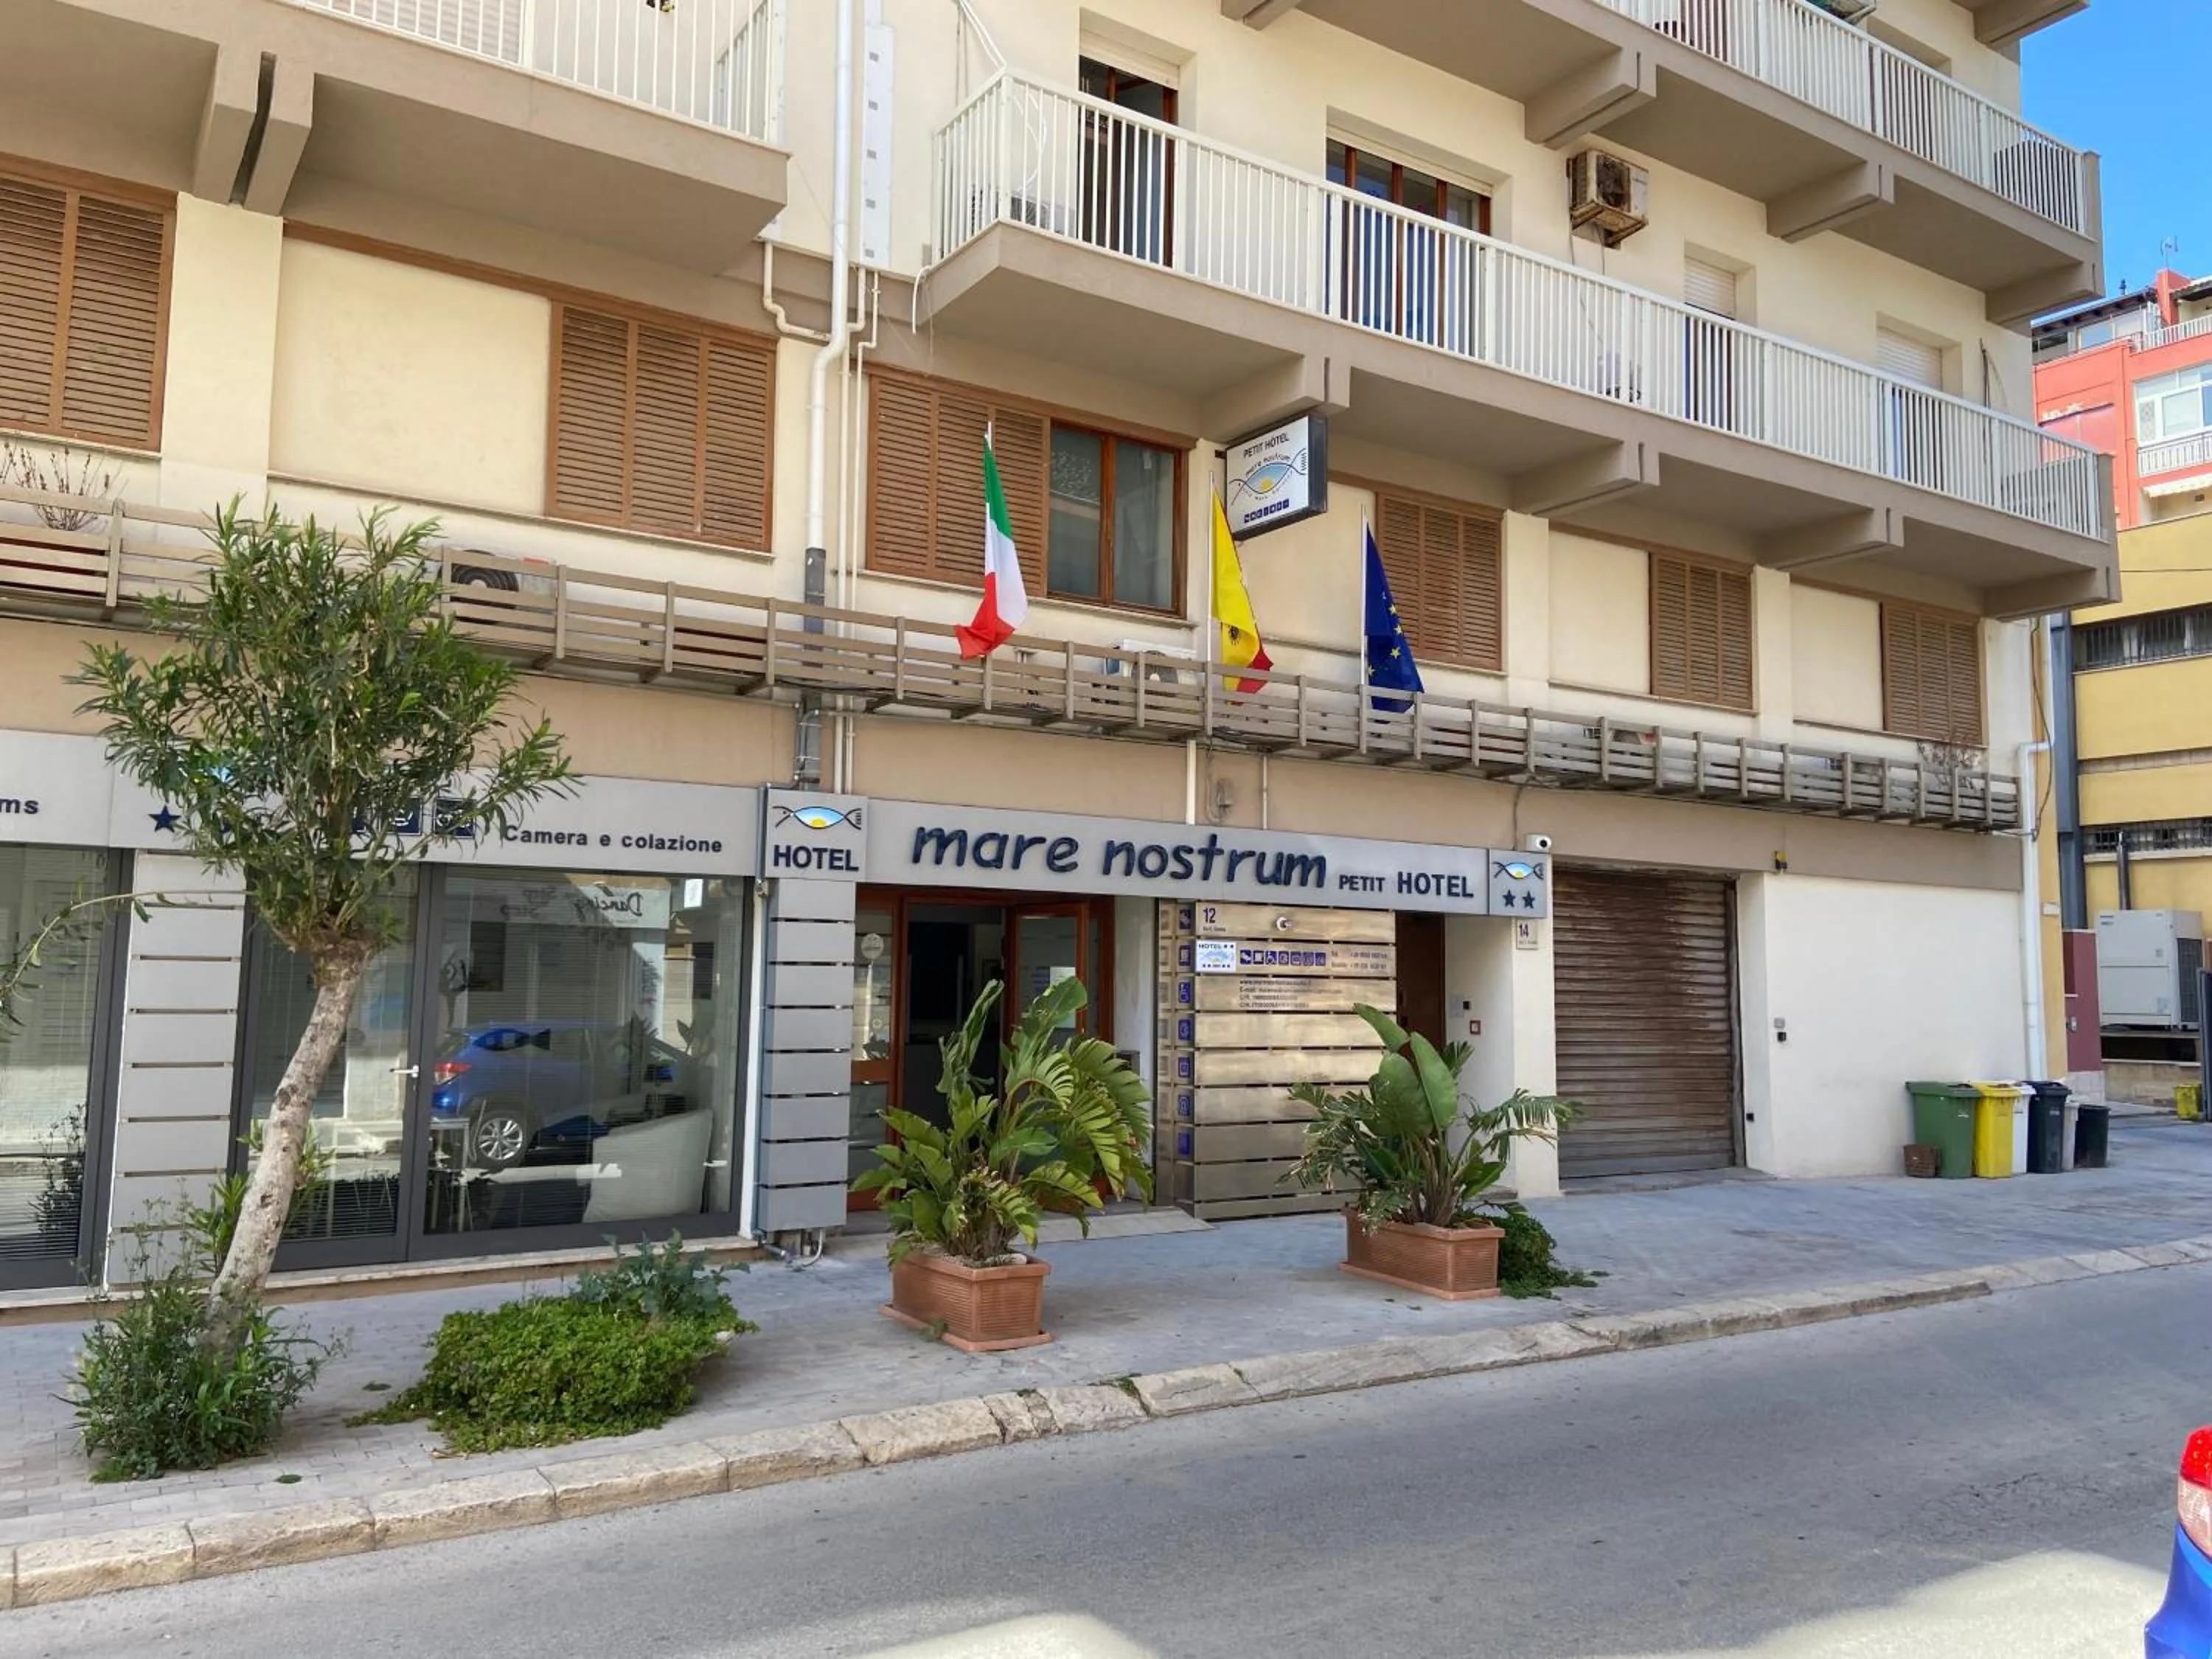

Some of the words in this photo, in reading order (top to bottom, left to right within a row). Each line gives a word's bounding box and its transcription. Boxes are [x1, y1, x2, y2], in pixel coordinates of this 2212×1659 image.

[1243, 442, 1264, 458] PETIT
[504, 824, 588, 846] Camera
[599, 833, 612, 847] e
[622, 831, 723, 853] colazione
[773, 844, 860, 872] HOTEL
[911, 826, 1079, 873] mare
[1102, 833, 1327, 888] nostrum
[1338, 873, 1386, 893] PETIT
[1397, 872, 1474, 898] HOTEL
[1203, 907, 1216, 924] 12
[1519, 922, 1529, 939] 14
